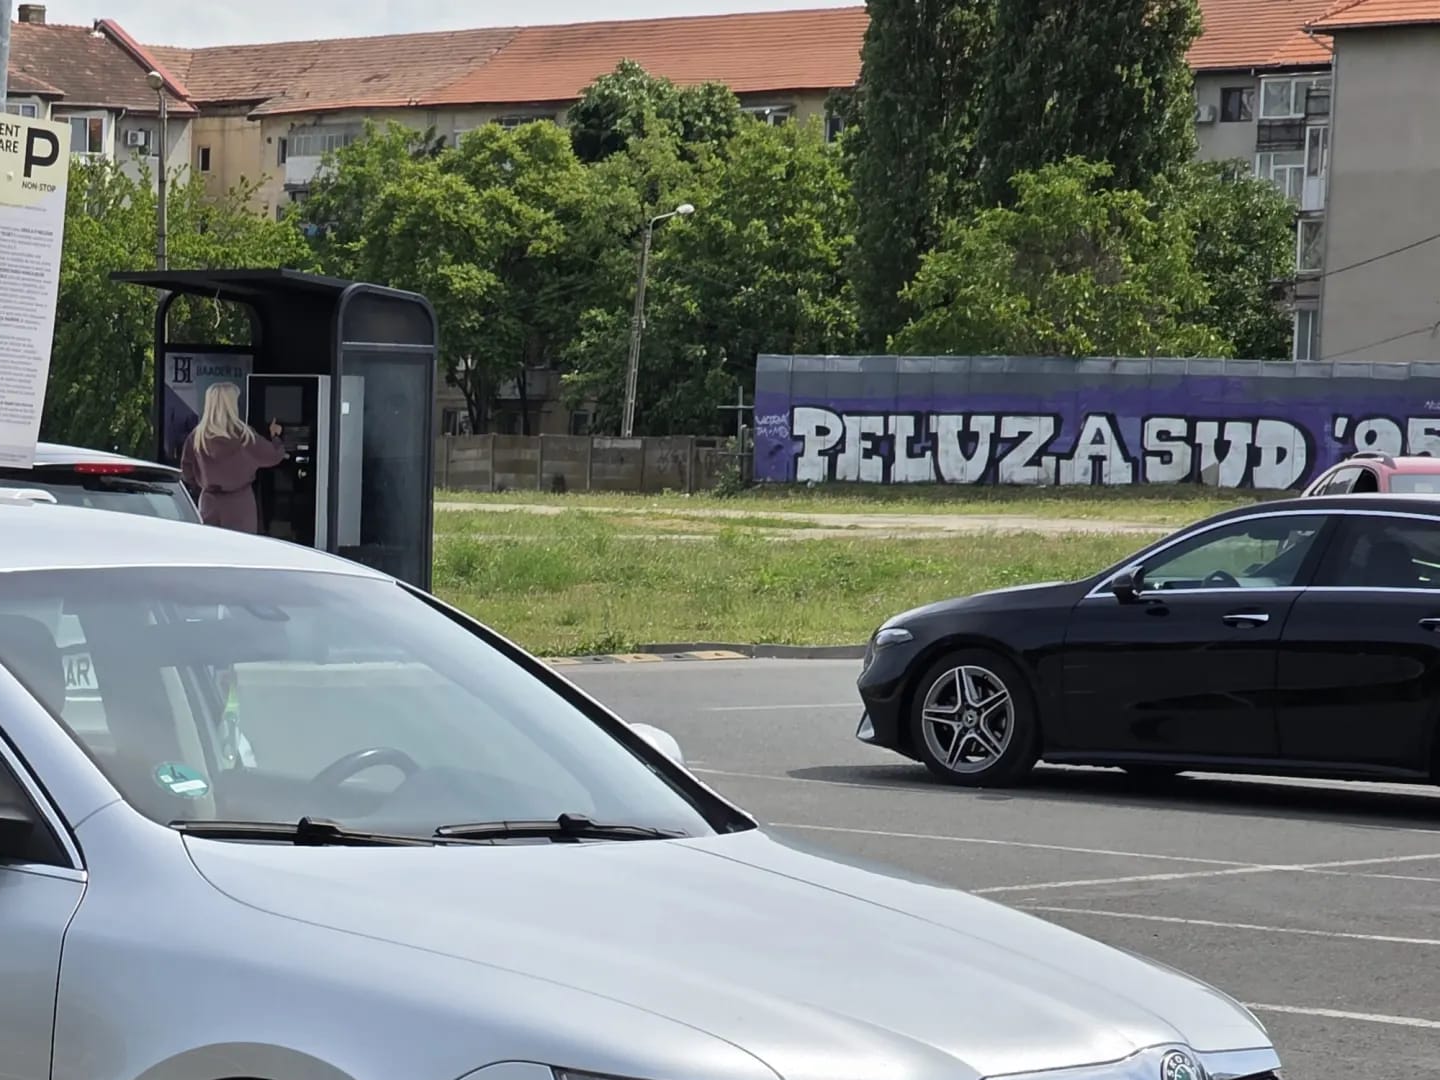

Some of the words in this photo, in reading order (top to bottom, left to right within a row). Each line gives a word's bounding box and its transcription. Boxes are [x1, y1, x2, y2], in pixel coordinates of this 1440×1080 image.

[24, 127, 59, 178] P
[792, 406, 1136, 486] PELUZA
[1142, 416, 1310, 490] SUD
